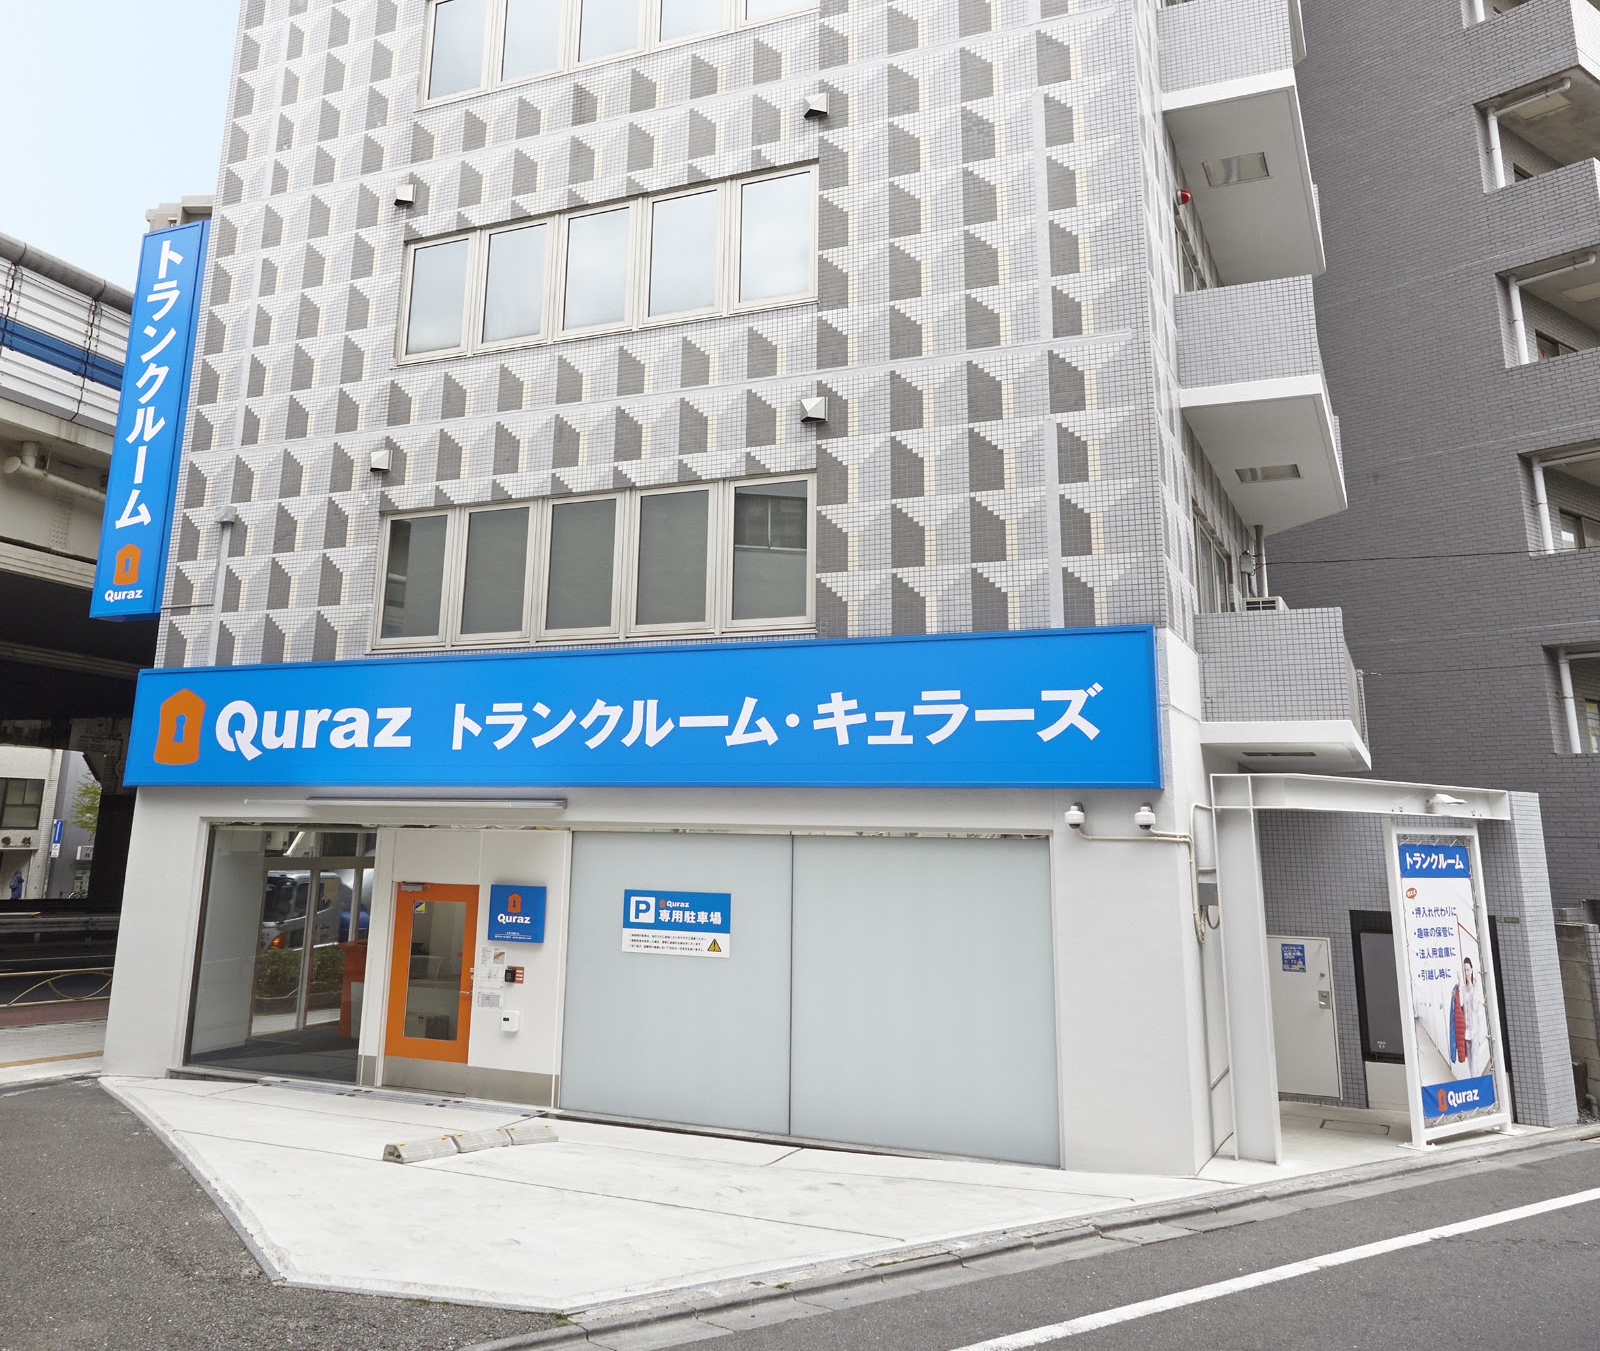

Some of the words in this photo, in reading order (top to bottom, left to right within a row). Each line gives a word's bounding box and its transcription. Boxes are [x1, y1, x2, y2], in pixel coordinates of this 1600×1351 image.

[115, 240, 184, 530] トランクルーム
[104, 589, 143, 603] Quraz
[215, 700, 412, 761] Quraz
[451, 682, 1104, 750] トランクルーム・キュラーズ
[1405, 852, 1465, 870] トランクルーム
[634, 900, 651, 919] P
[666, 900, 690, 908] Quraz
[497, 913, 531, 924] Quraz
[658, 909, 722, 925] 専用駐車場
[1447, 1088, 1480, 1108] Quraz
